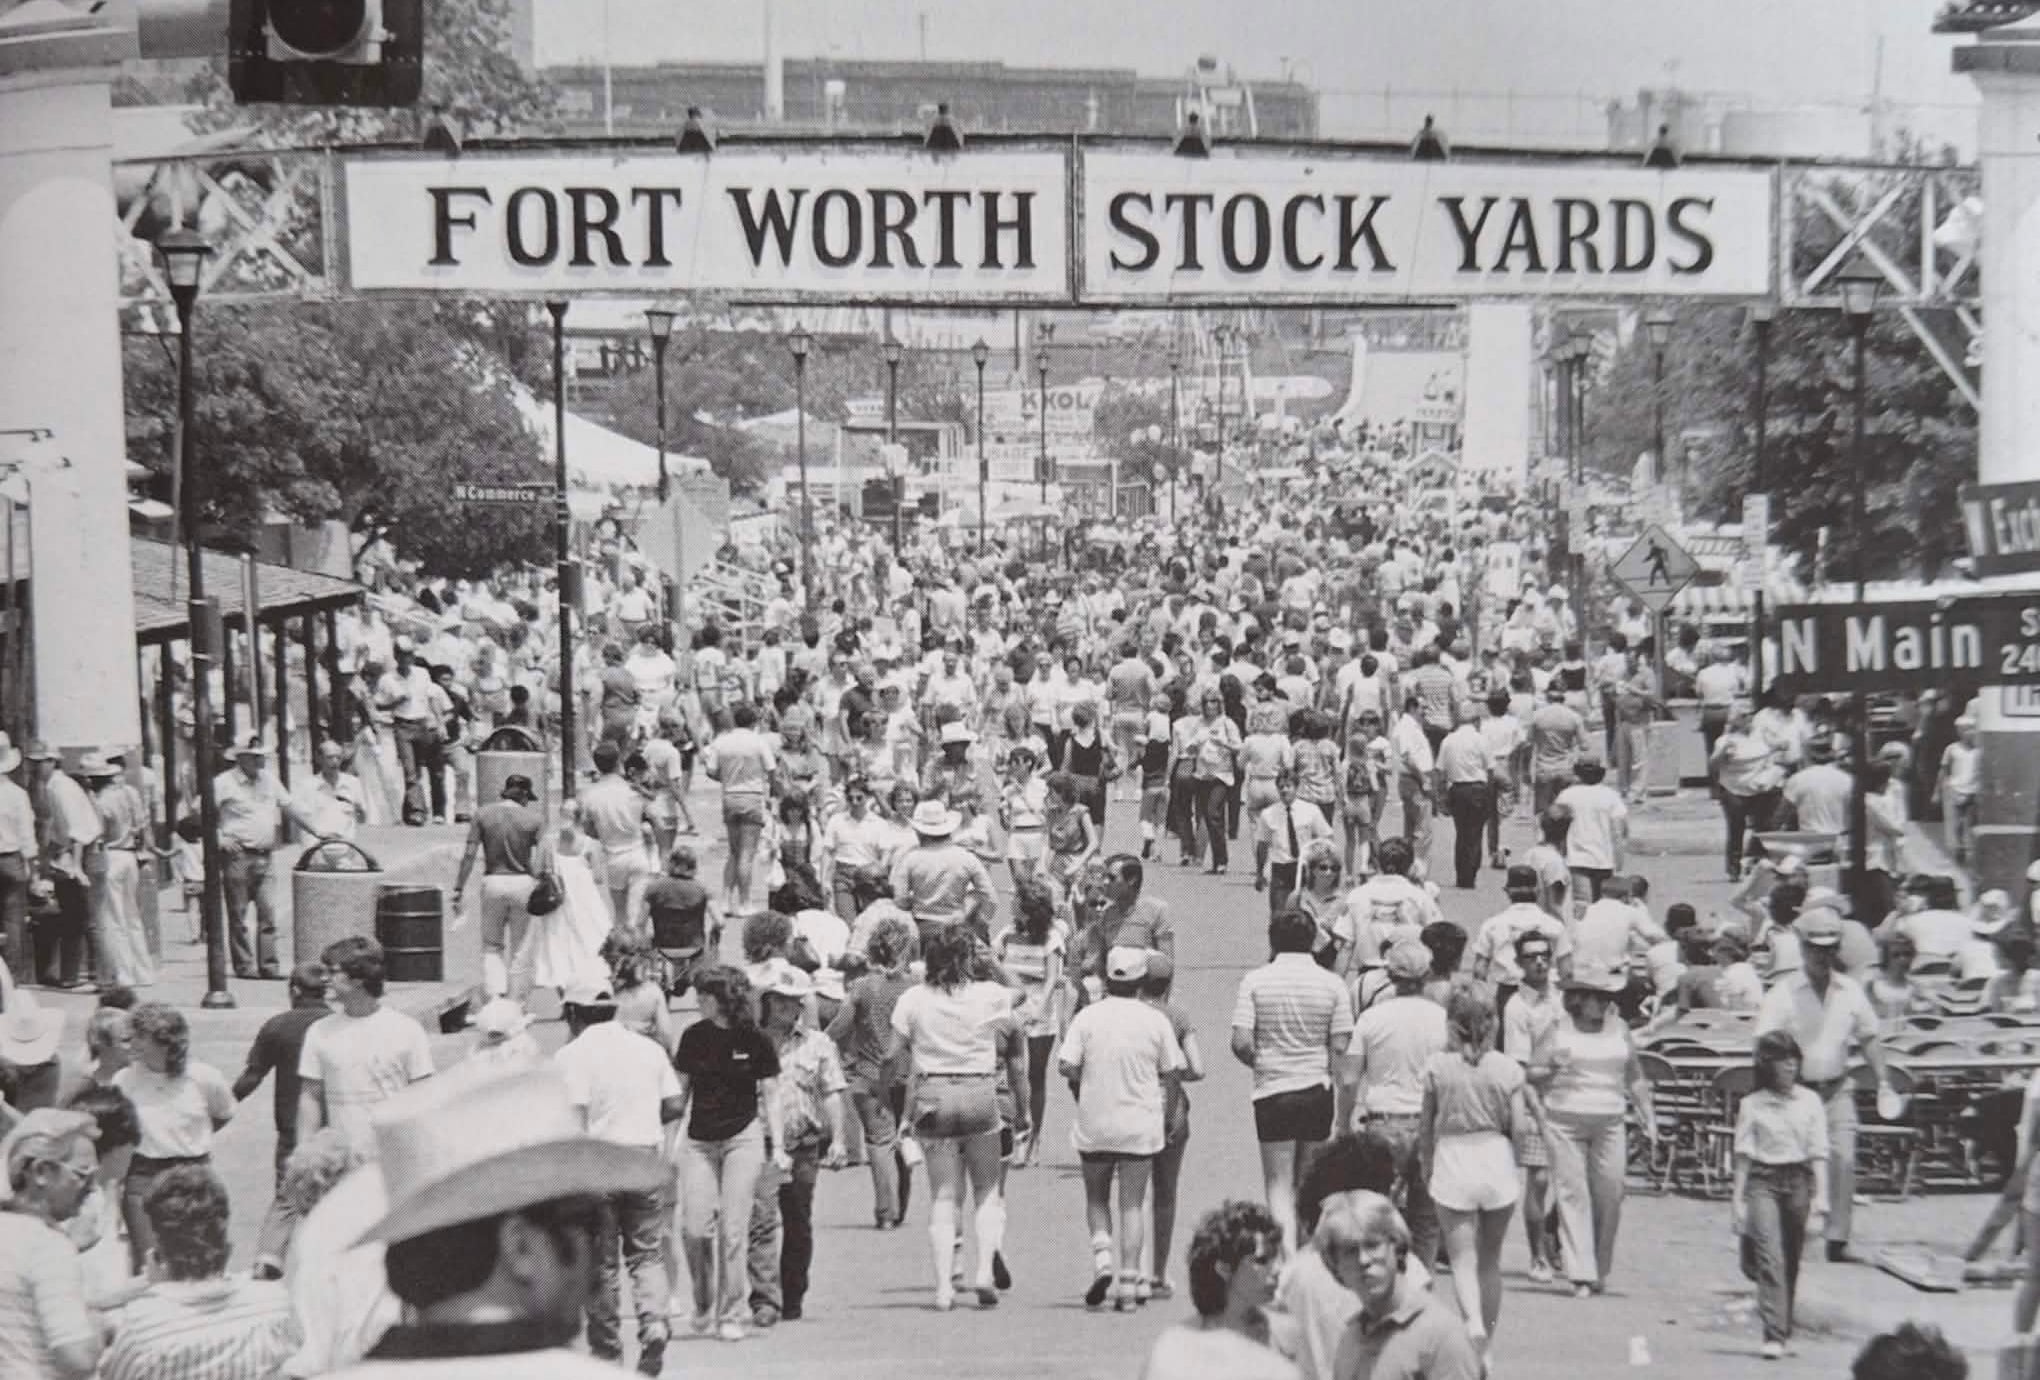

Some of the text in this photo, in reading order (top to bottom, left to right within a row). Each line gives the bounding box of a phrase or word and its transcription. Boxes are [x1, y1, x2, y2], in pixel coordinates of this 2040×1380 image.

[427, 187, 1714, 275] FORT WORTH STOCK YARDS
[468, 487, 535, 500] Commerce
[1781, 612, 1982, 674] N Main
[2021, 607, 2040, 637] S
